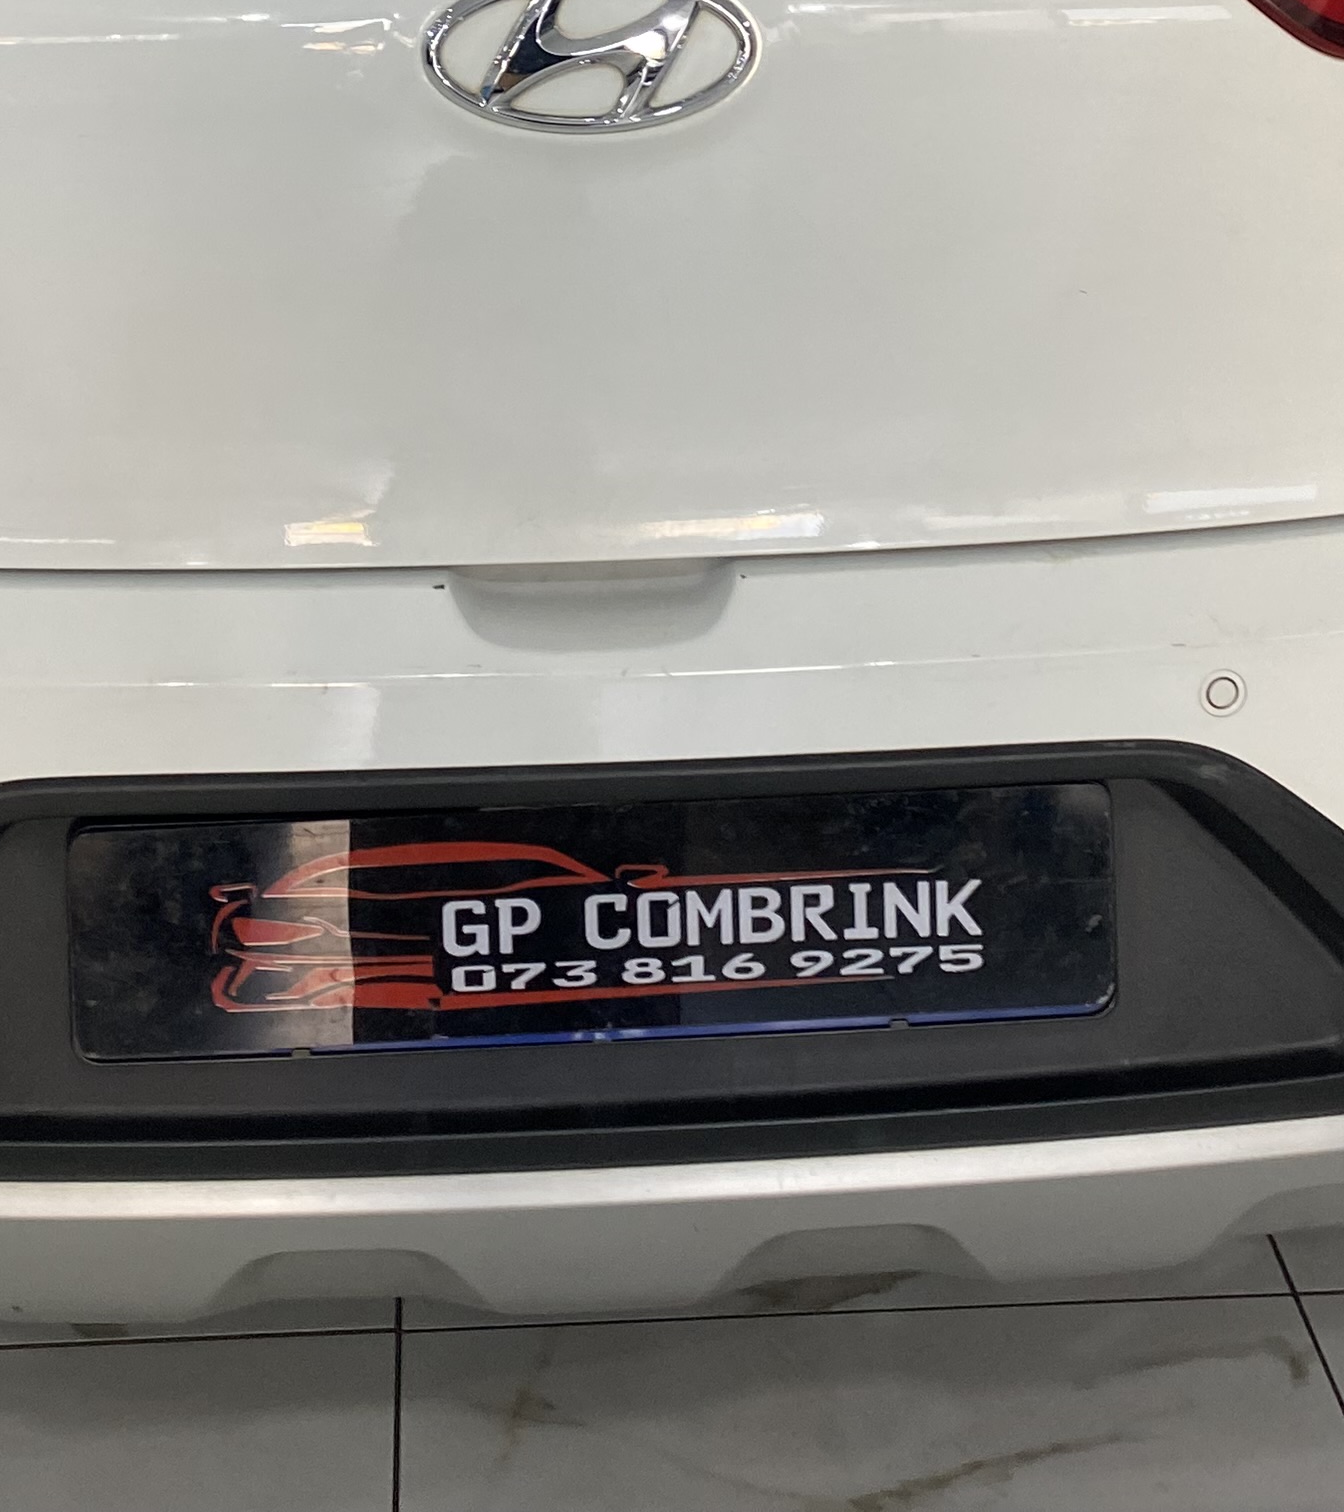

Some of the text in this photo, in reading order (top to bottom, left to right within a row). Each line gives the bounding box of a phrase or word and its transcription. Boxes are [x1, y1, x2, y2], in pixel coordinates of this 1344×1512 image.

[442, 878, 984, 957] GP COMBRINK
[451, 943, 984, 994] 073 816 9275
